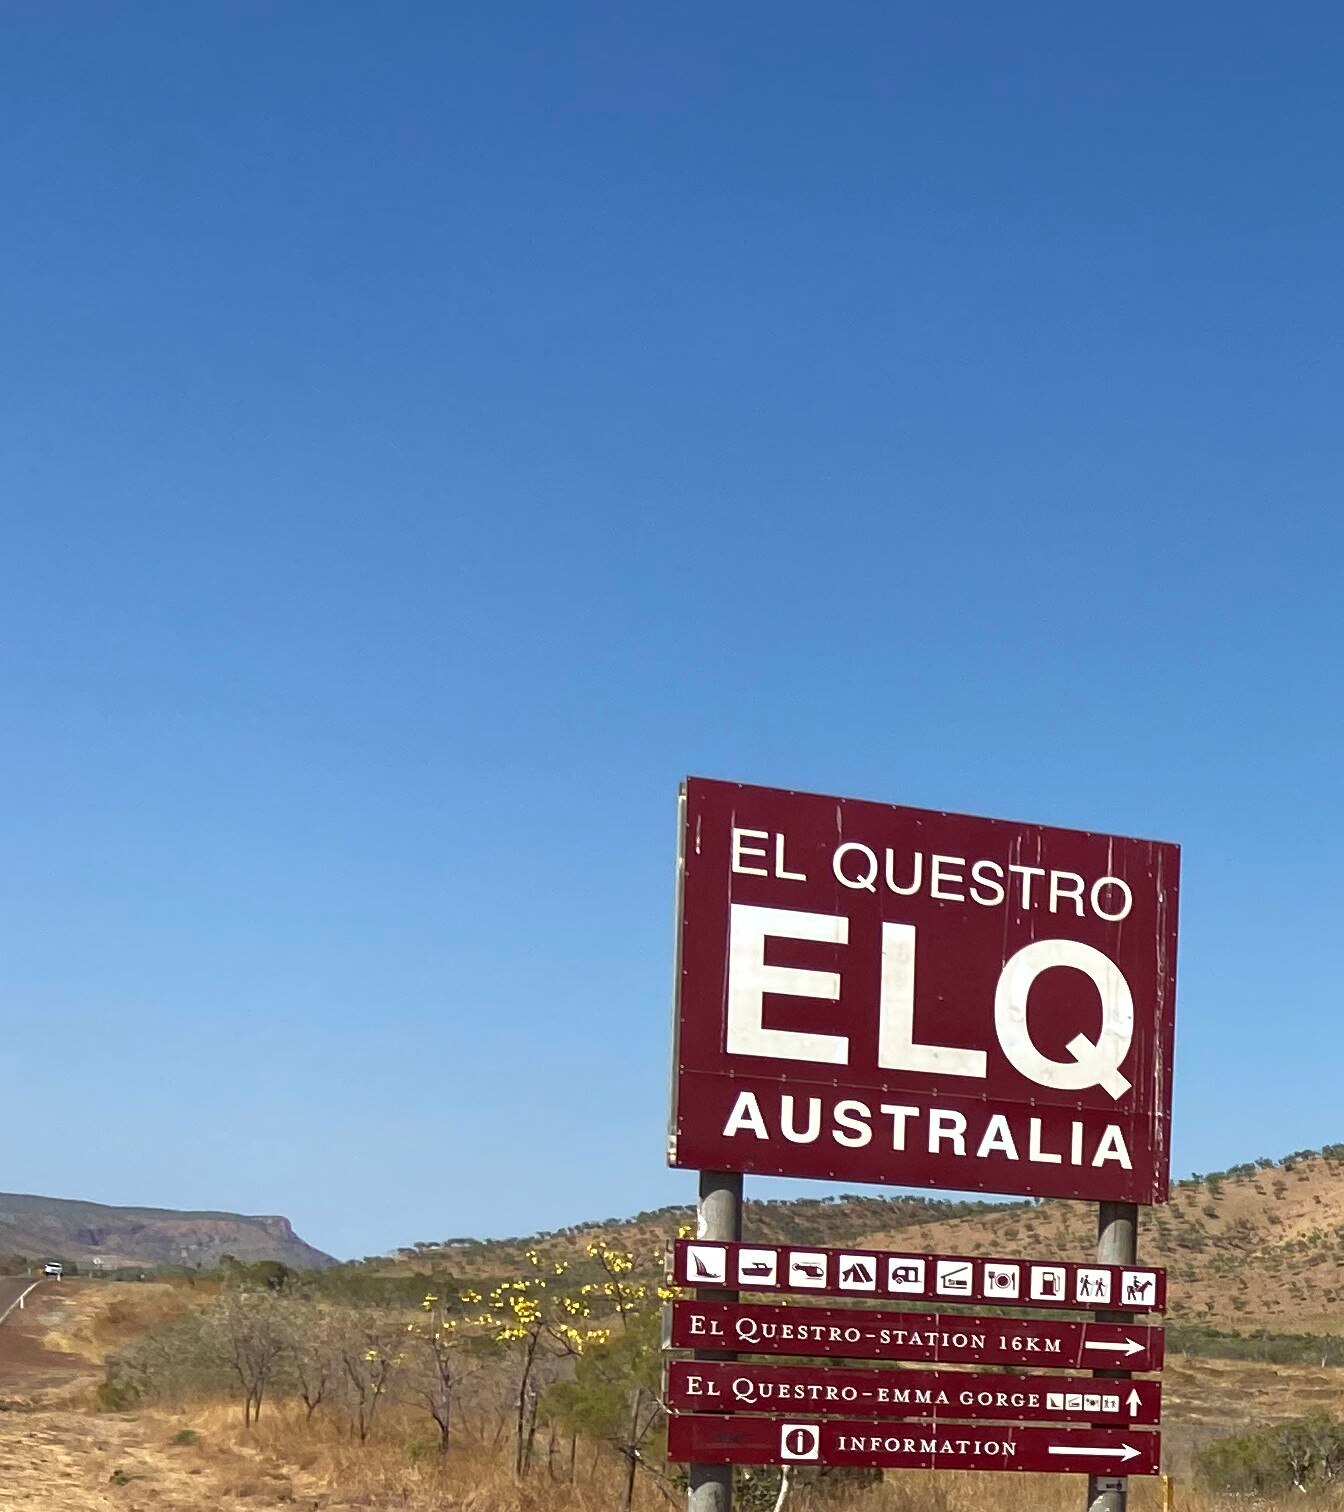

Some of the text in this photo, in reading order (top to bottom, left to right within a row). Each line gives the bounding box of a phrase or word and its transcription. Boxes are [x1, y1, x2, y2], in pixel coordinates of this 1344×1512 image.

[731, 827, 1133, 923] EL QUESTRO
[726, 902, 1135, 1101] ELQ
[722, 1090, 1134, 1170] AUSTRALIA
[689, 1314, 724, 1337] EL
[999, 1336, 1062, 1354] 16KM
[686, 1375, 721, 1397] EL
[960, 1390, 1041, 1409] GORGE
[837, 1435, 1018, 1457] INFORMATION
